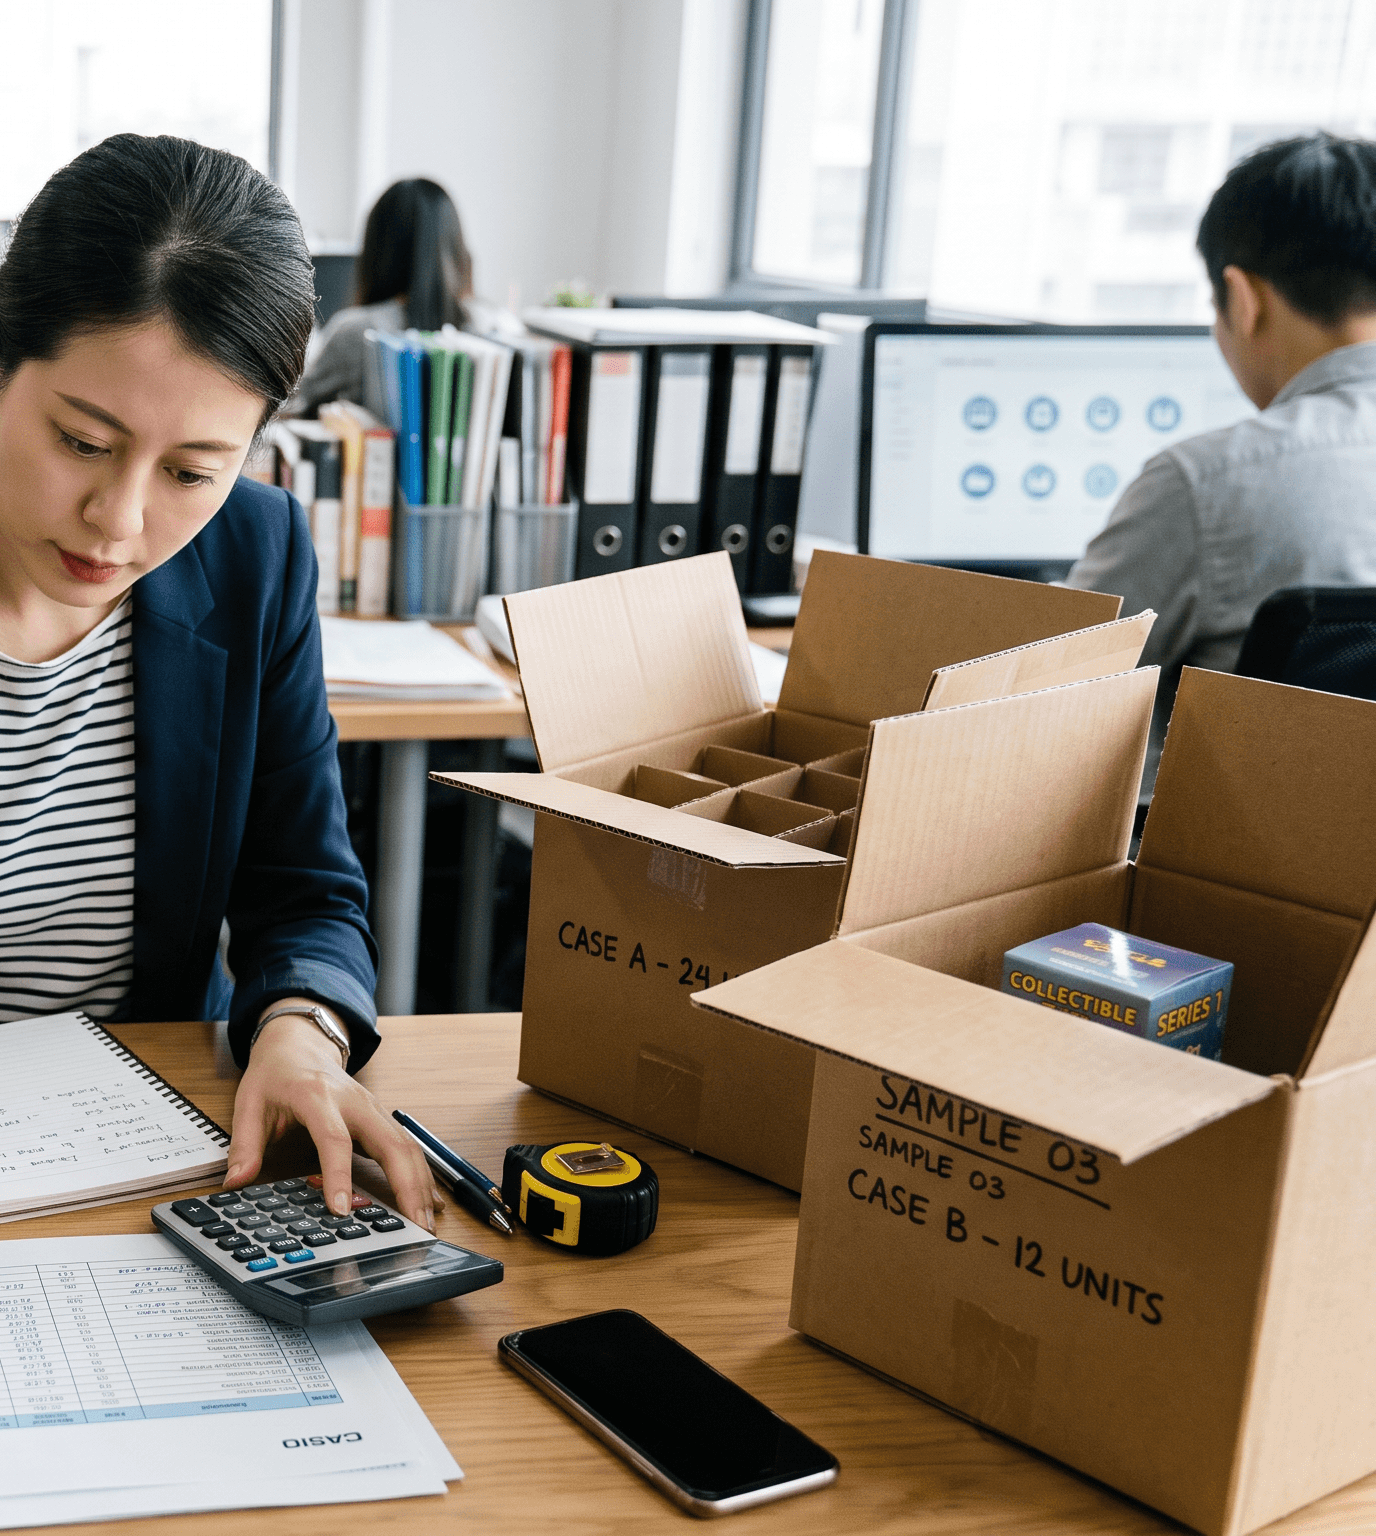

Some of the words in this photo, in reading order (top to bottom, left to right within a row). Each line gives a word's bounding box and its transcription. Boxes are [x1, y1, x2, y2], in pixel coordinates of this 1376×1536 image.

[558, 921, 618, 962] CASE
[628, 942, 647, 973] A
[678, 957, 710, 989] 24
[1009, 971, 1137, 1026] COLLECTIBLE
[1156, 996, 1211, 1037] SERIES
[1215, 990, 1223, 1013] 1
[859, 1125, 954, 1179] SAMPLE
[969, 1170, 1005, 1199] 03
[876, 1074, 1022, 1153] SAMPLE
[1048, 1140, 1100, 1185] 03
[847, 1168, 930, 1225] CASE
[945, 1206, 968, 1243] B
[1014, 1236, 1046, 1278] 12
[1061, 1256, 1164, 1326] UNITS
[282, 1431, 363, 1449] CASIO
